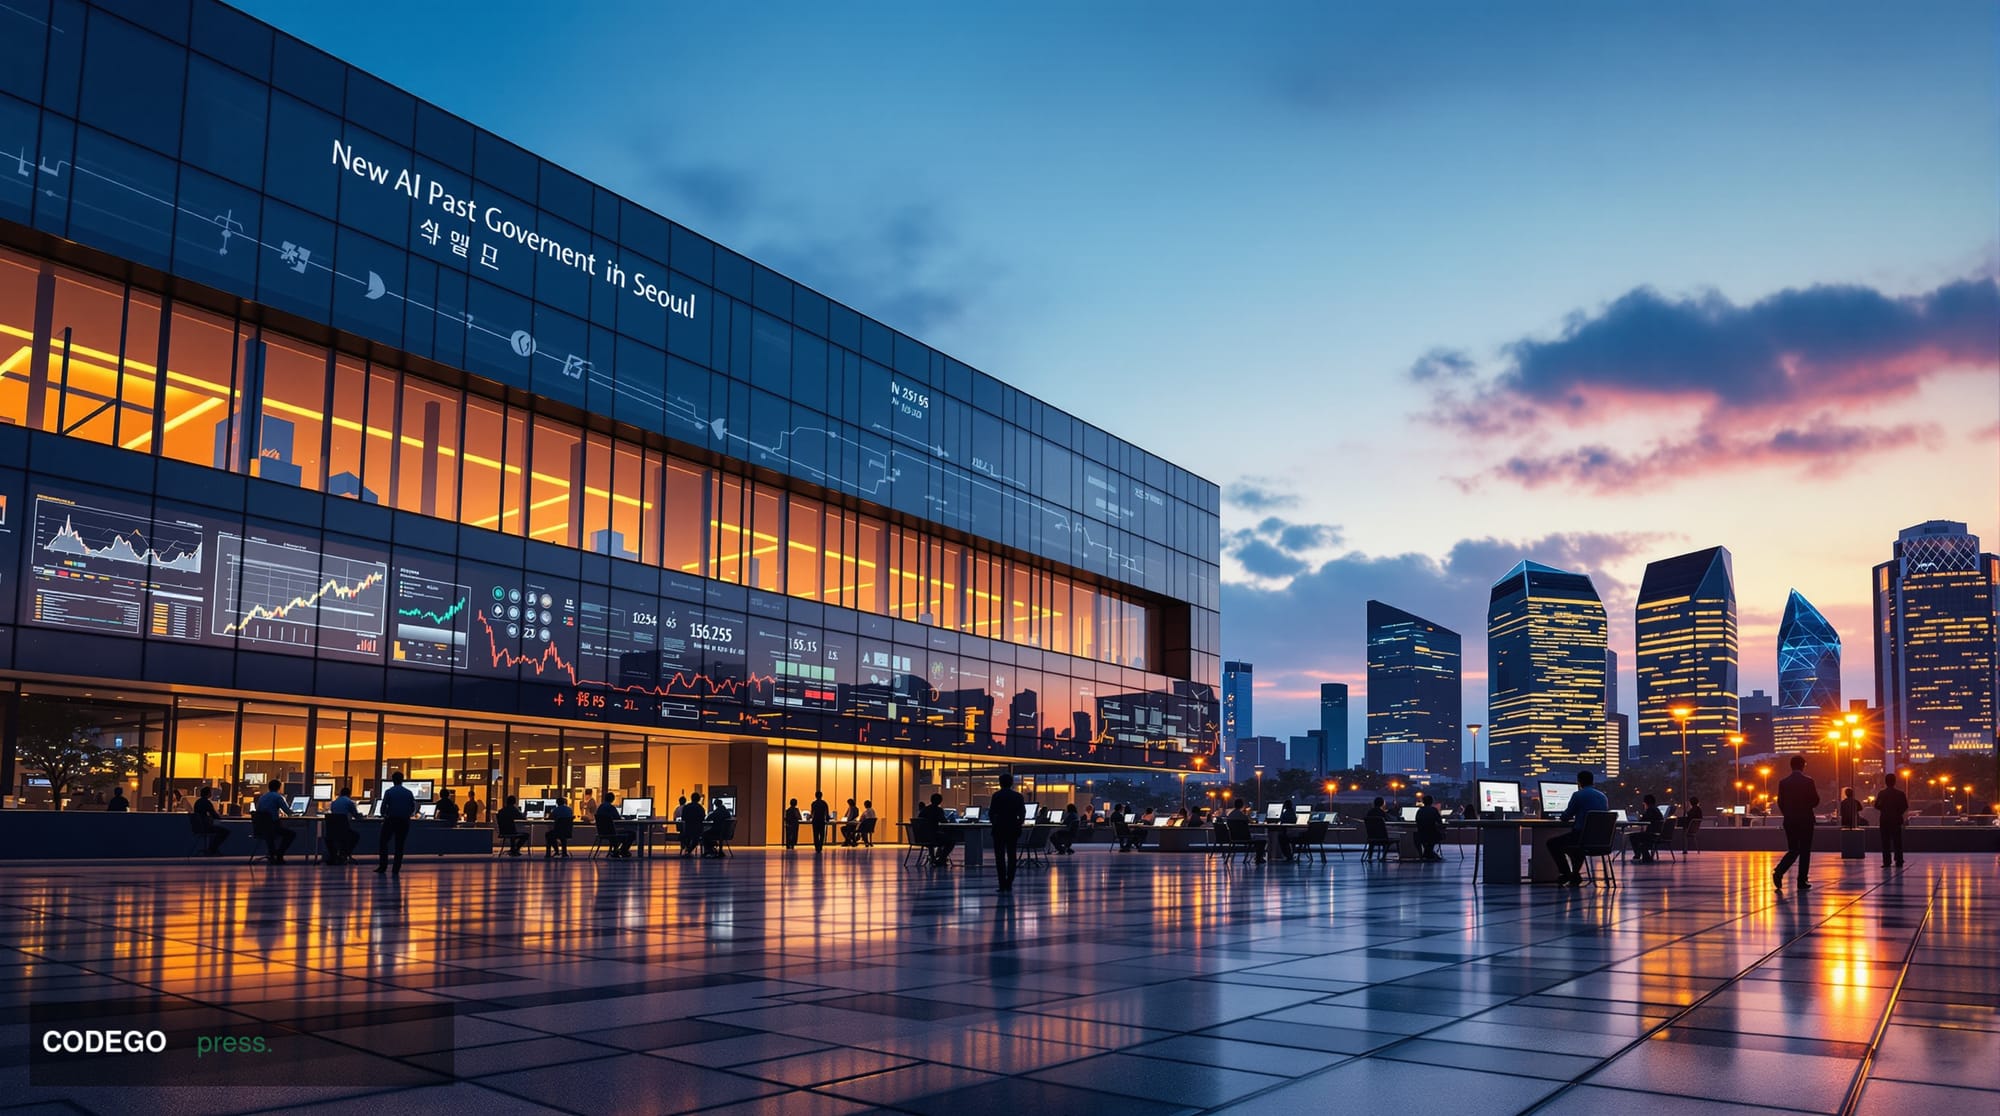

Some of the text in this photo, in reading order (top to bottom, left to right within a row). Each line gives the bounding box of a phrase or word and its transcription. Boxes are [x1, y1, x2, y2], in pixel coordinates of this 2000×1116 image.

[332, 139, 389, 185] New
[394, 168, 421, 199] AI
[428, 180, 477, 223] Past
[484, 207, 597, 276] Governent
[689, 622, 733, 643] 156.255
